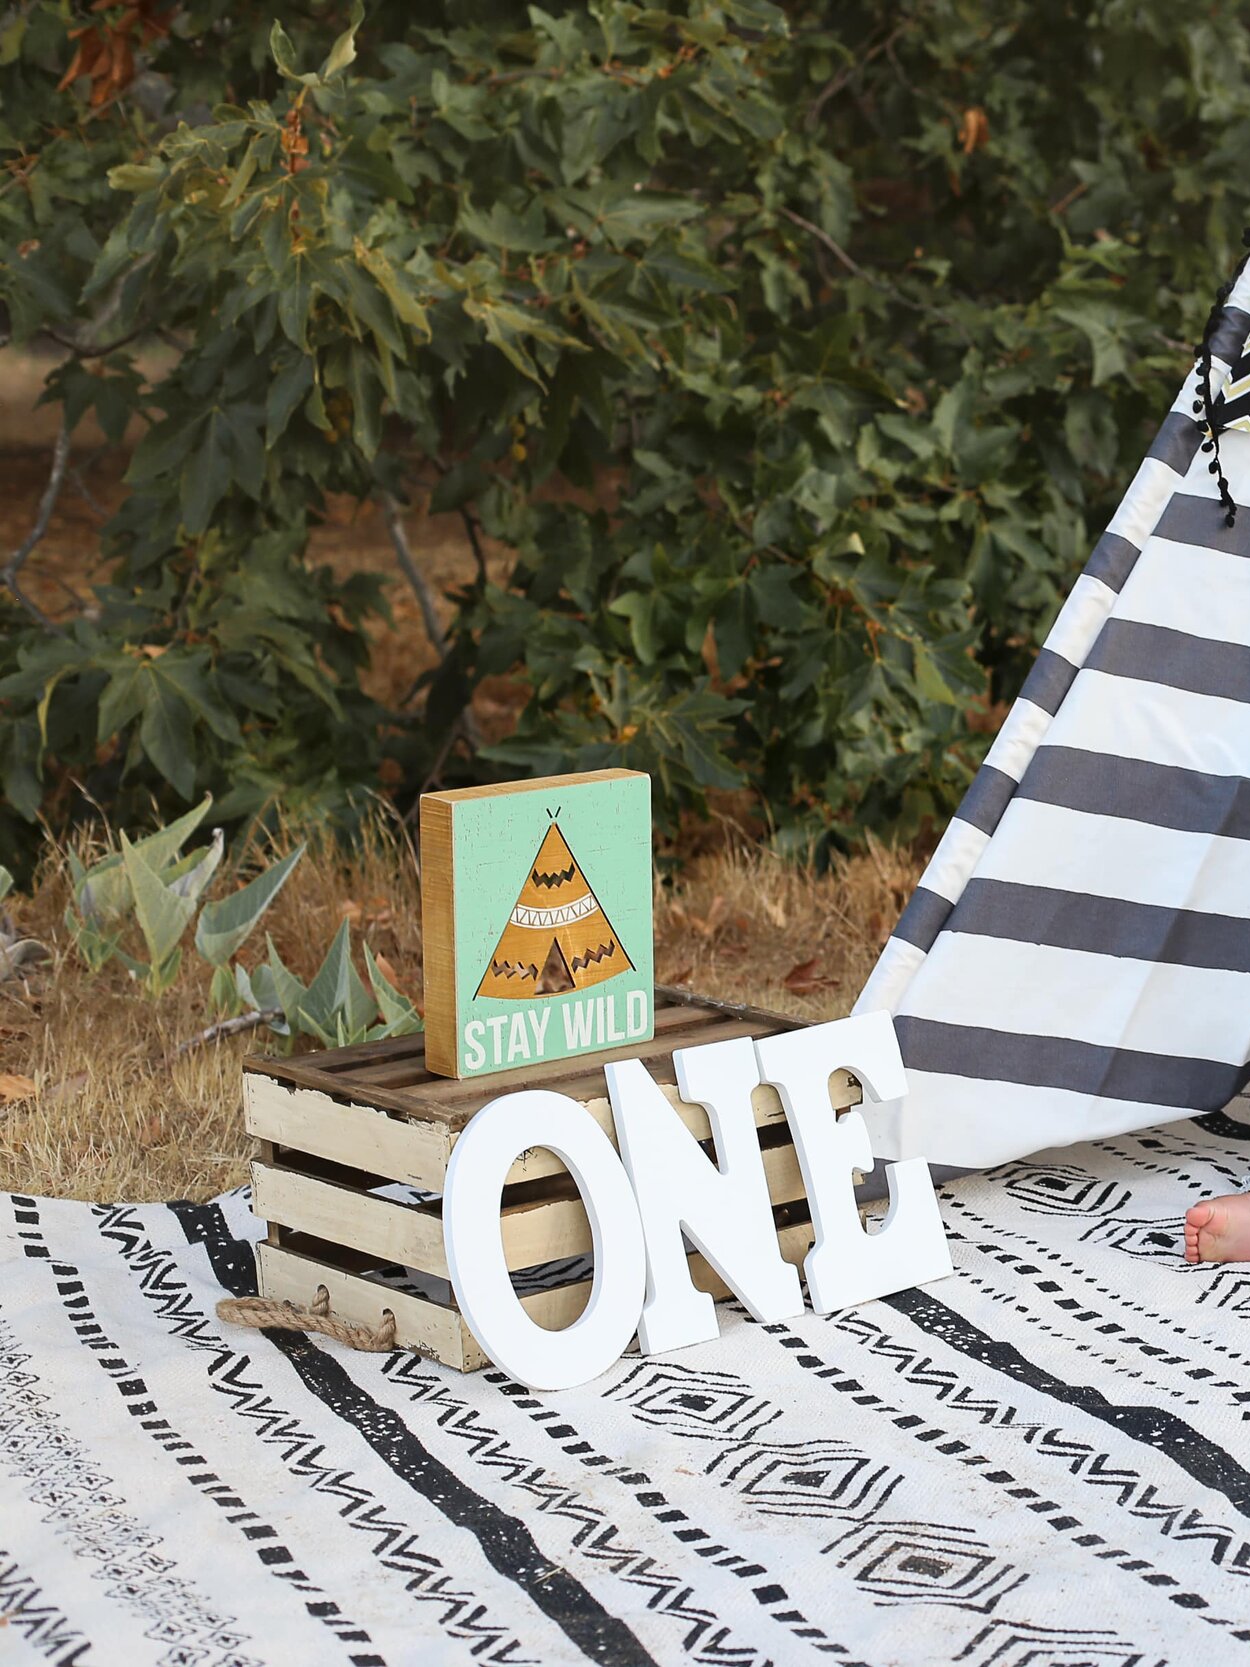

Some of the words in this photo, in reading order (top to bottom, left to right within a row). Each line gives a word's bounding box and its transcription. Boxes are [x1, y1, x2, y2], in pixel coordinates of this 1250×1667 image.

[464, 1007, 551, 1070] STAY
[562, 990, 648, 1050] WILD
[442, 1009, 954, 1391] ONE
